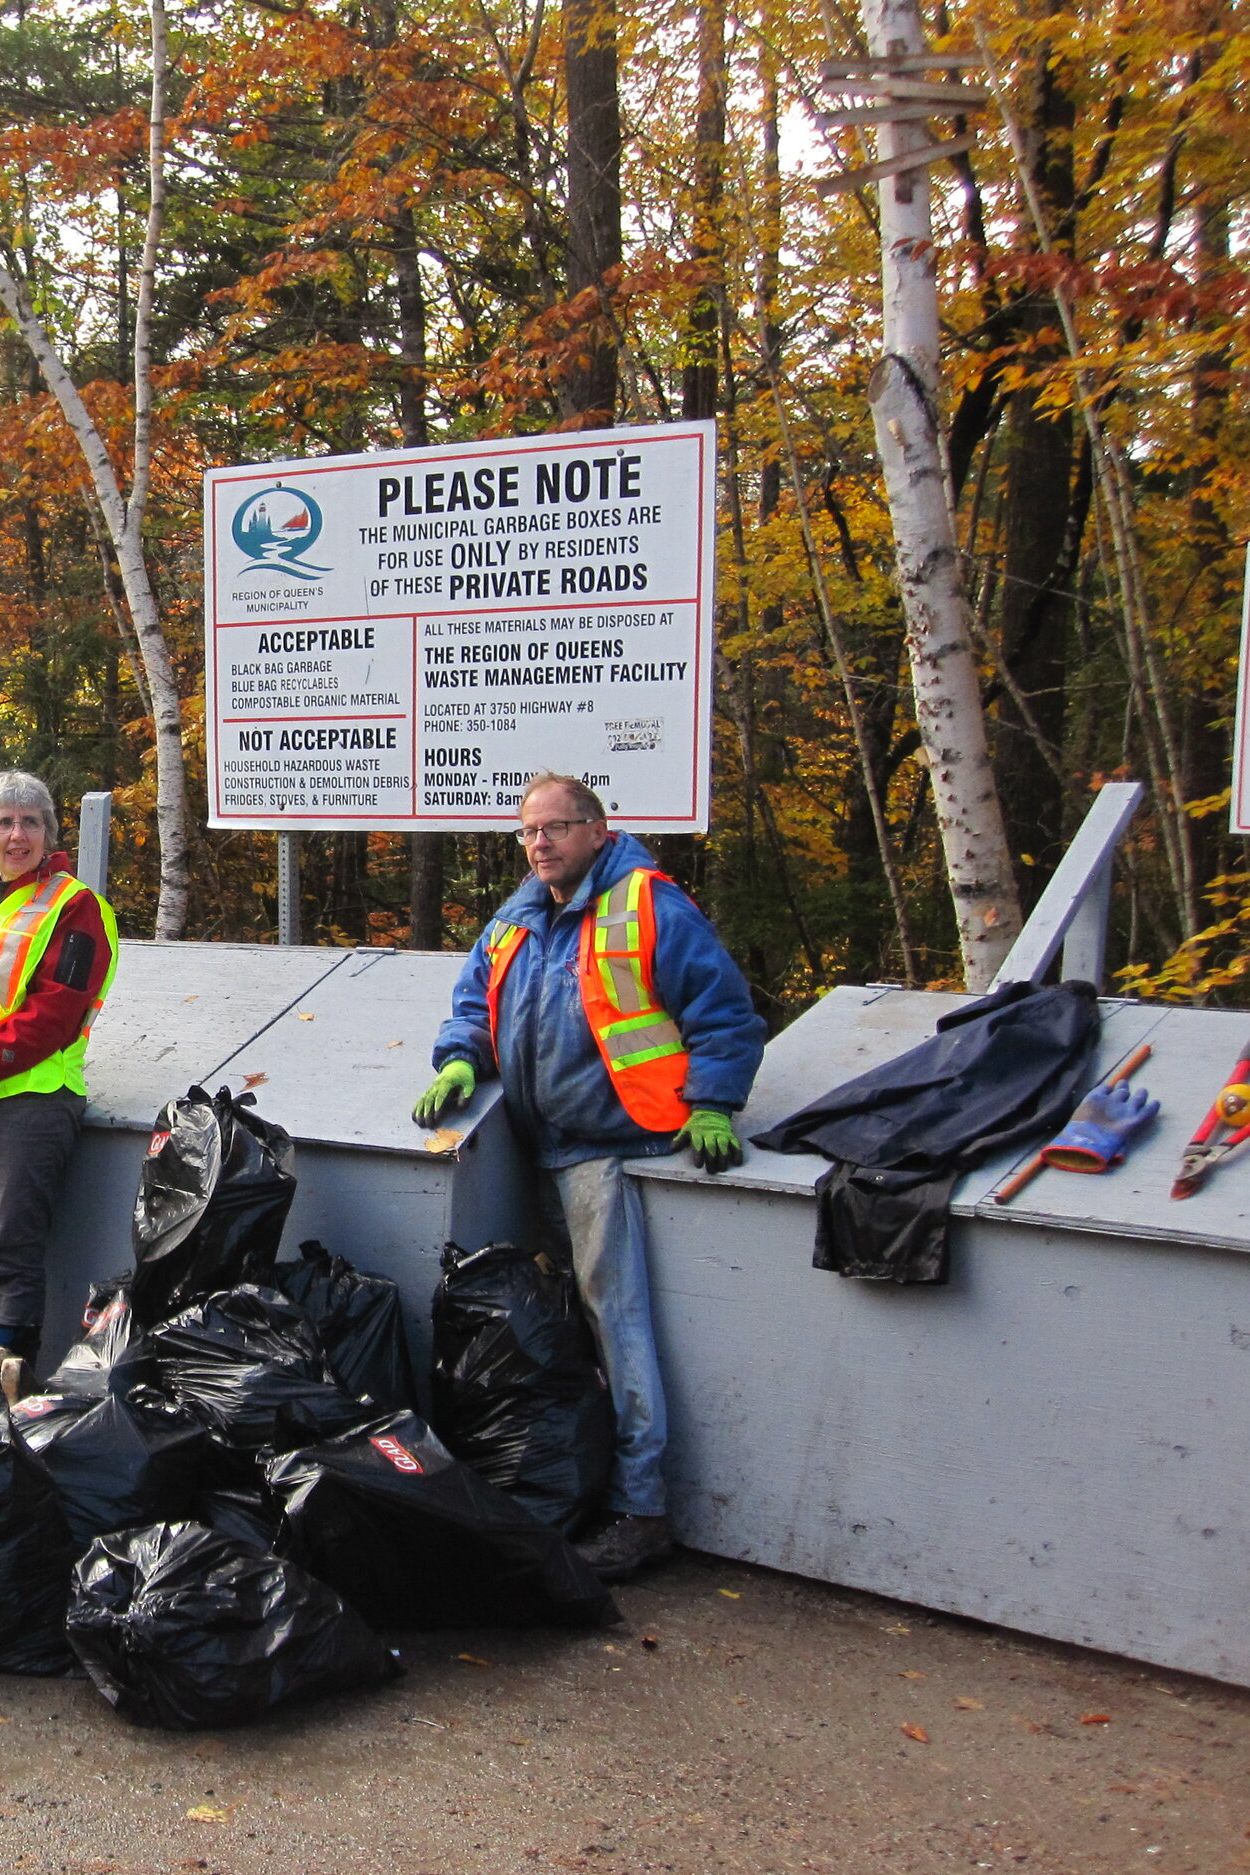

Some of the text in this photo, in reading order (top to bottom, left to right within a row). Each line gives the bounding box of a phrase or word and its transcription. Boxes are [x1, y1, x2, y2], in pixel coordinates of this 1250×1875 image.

[378, 455, 641, 518] PLEASE NOTE
[359, 505, 662, 544] THE MUNICIPAL GARBAGE BOXES ARE
[378, 535, 639, 570] FOR USE ONLY BY RESIDENTS
[370, 563, 647, 600] OF THESE PRIVATE ROADS
[232, 587, 324, 601] REGION OF QUEEN'S
[246, 601, 309, 613] MUNICIPALITY
[424, 612, 674, 636] ALL THESE MATERIALS MAY BE DISPOSED AT
[258, 627, 375, 654] ACCEPTABLE
[424, 639, 624, 665] THE REGION OF QUEENS
[231, 660, 332, 676] BLACK BAG GARBAGE
[424, 662, 687, 689] WASTE MANAGEMENT FACILITY
[231, 677, 339, 692] BLUE BAG RECYCLABLES
[231, 692, 400, 710] COMPOSTABLE ORGANIC MATERIAL
[424, 700, 594, 716] LOCATED AT 3750 HIGHWAY #8
[424, 718, 516, 733] PHONE: 350-1084
[239, 727, 397, 751] NOT ACCEPTABLE
[224, 759, 380, 772] HOUSEHOLD HAZARDOUS WASTE
[424, 748, 482, 767] HOURS
[224, 776, 410, 789] CONSTRUCTION & DEMOLITION DEBRIS
[424, 772, 477, 787] MONDAY
[225, 794, 378, 807] FRIDGES, STOVES, & FURNITURE
[424, 792, 491, 806] SATURDAY:
[378, 1439, 418, 1470] GLAD
